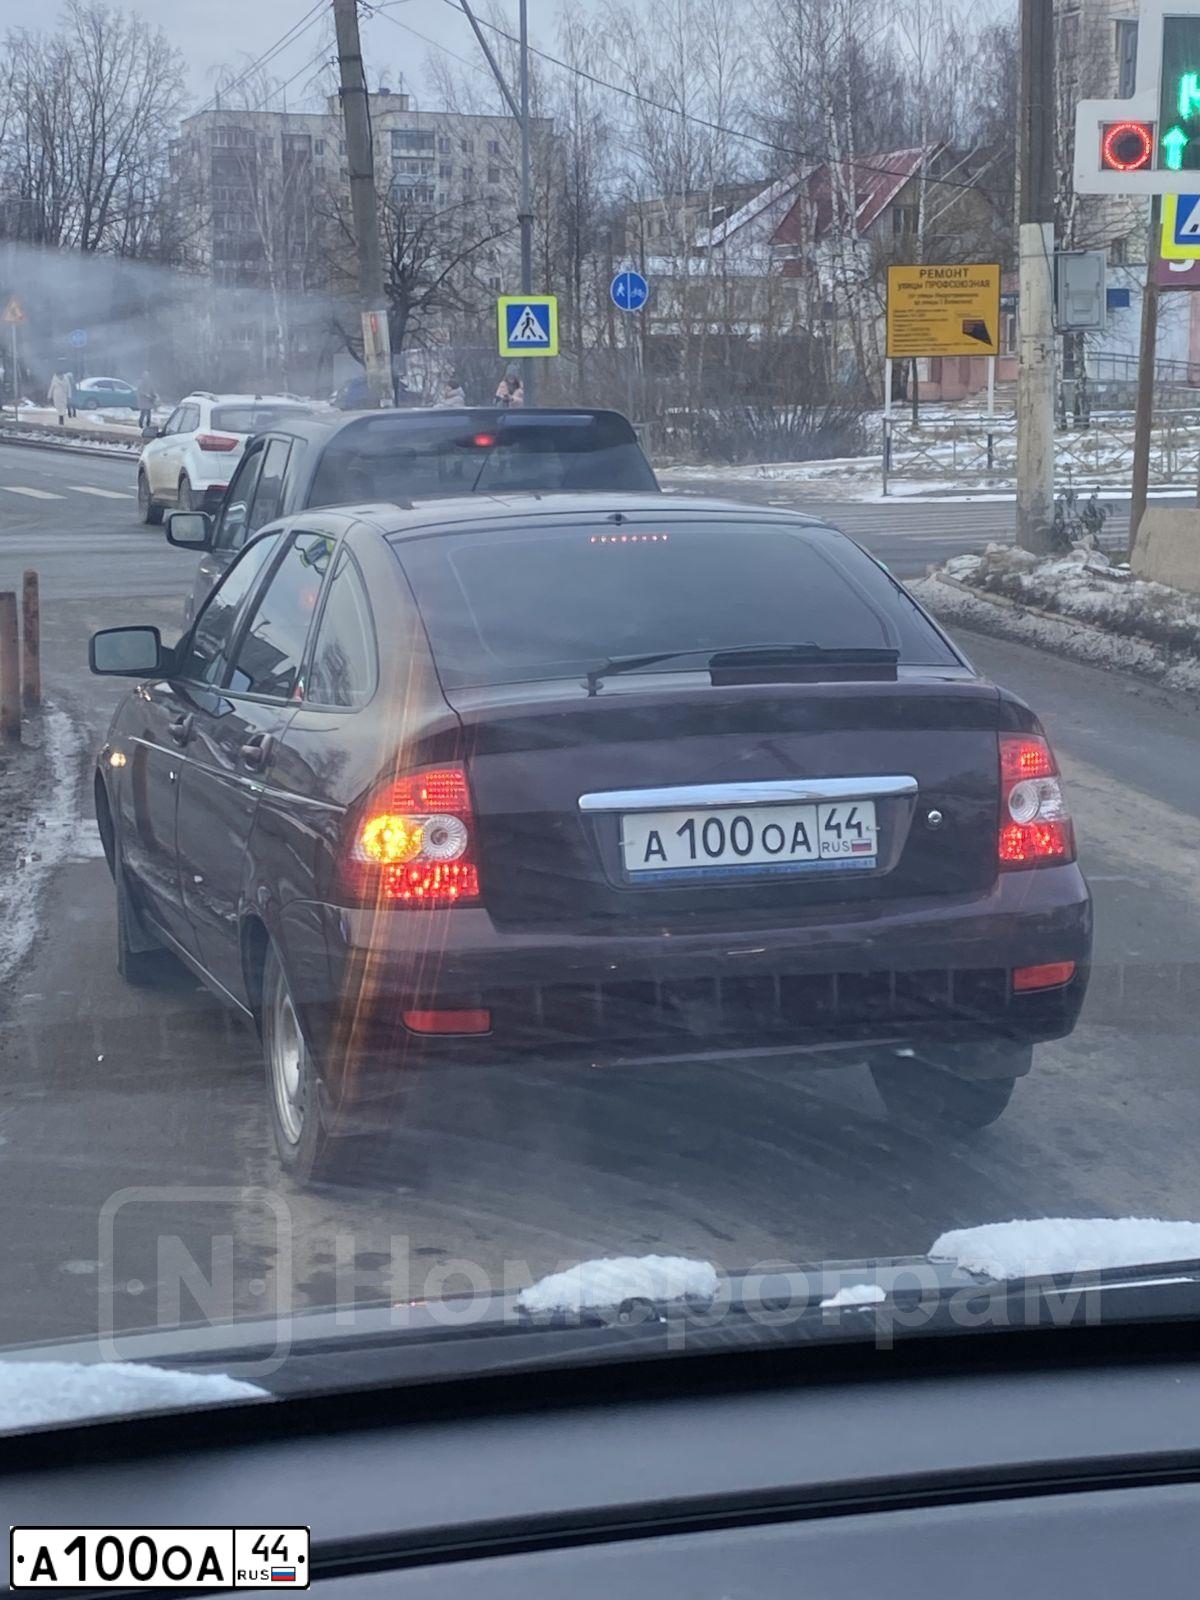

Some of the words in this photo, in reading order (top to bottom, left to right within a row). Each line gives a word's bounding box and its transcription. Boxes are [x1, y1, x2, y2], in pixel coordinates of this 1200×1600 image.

[919, 268, 969, 279] РЕМОНТ
[924, 279, 991, 290] ПРОФСОЮЗНАЯ
[824, 806, 863, 840] 44
[821, 840, 851, 853] RUS
